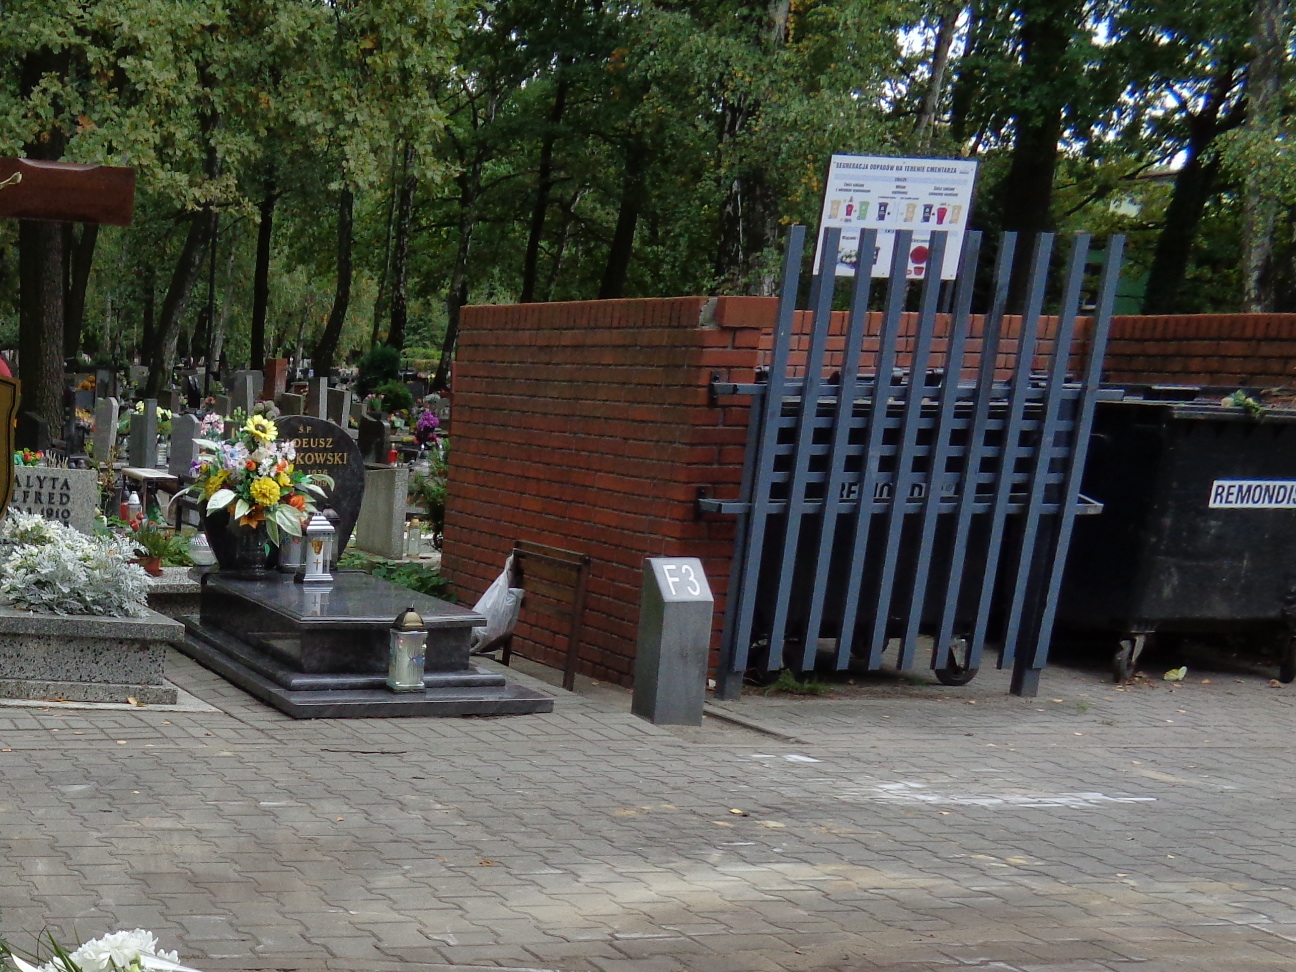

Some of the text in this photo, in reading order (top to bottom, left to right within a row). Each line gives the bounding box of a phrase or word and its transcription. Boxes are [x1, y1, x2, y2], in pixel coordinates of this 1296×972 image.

[281, 438, 333, 449] DEUSZ
[290, 452, 349, 465] KOWSKI
[14, 474, 71, 491] ALYTA
[11, 489, 71, 506] LFRED
[662, 564, 701, 596] F3
